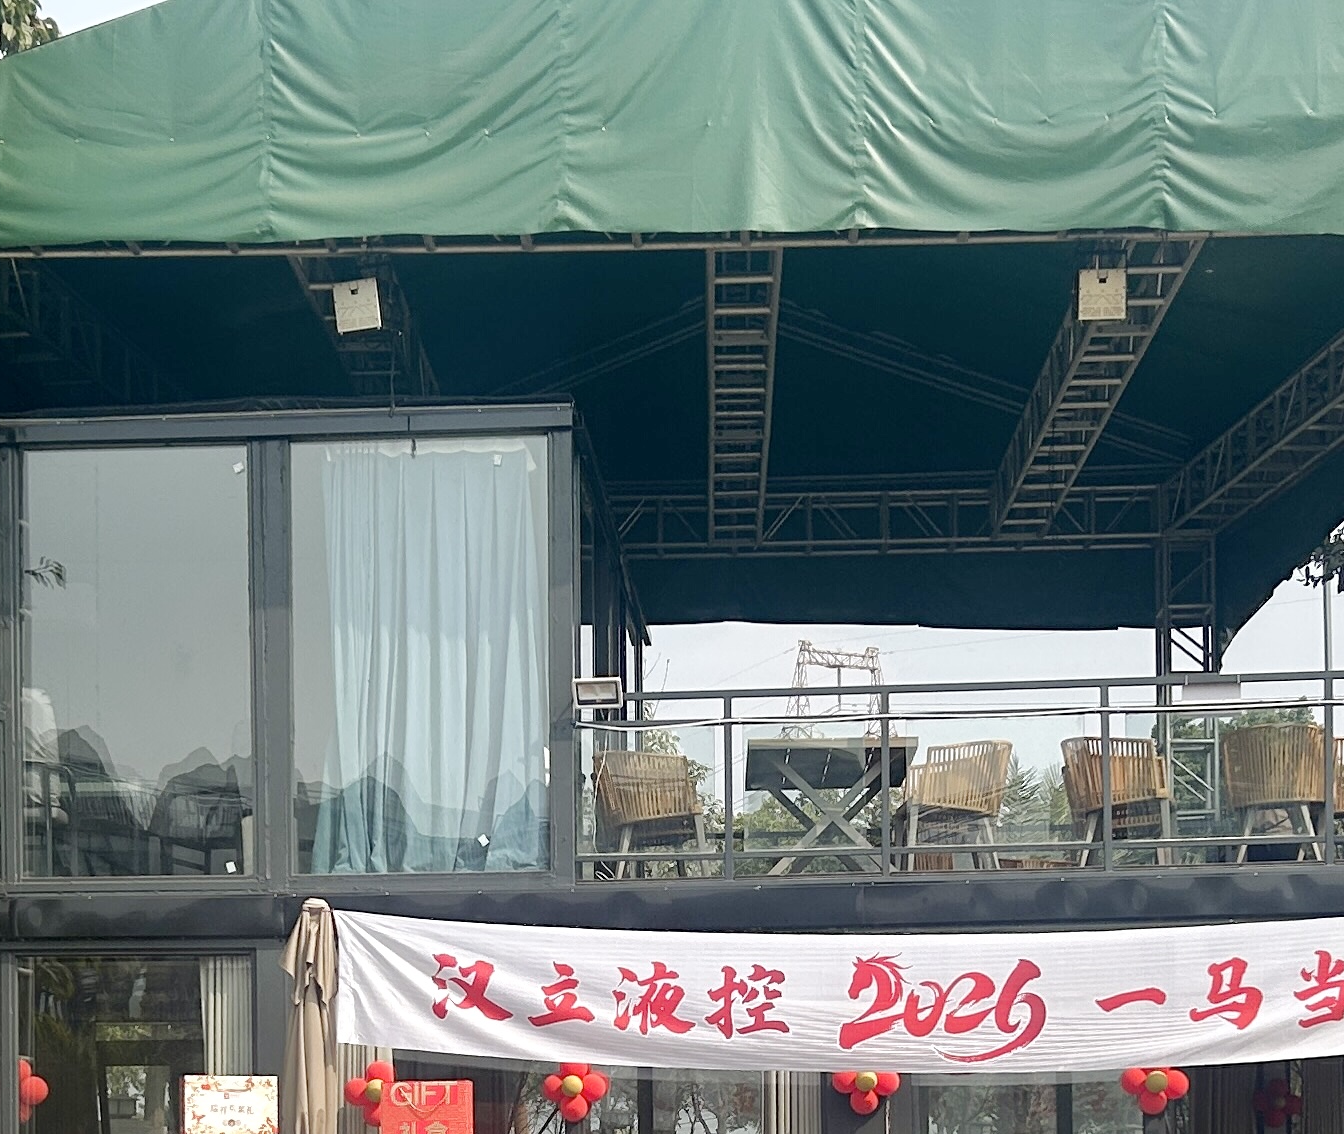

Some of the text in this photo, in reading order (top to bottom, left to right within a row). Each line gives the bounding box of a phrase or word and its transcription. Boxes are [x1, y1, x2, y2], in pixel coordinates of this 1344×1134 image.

[431, 953, 790, 1039] 汉立液控
[836, 951, 1048, 1064] 2026
[390, 1081, 458, 1106] GIFT
